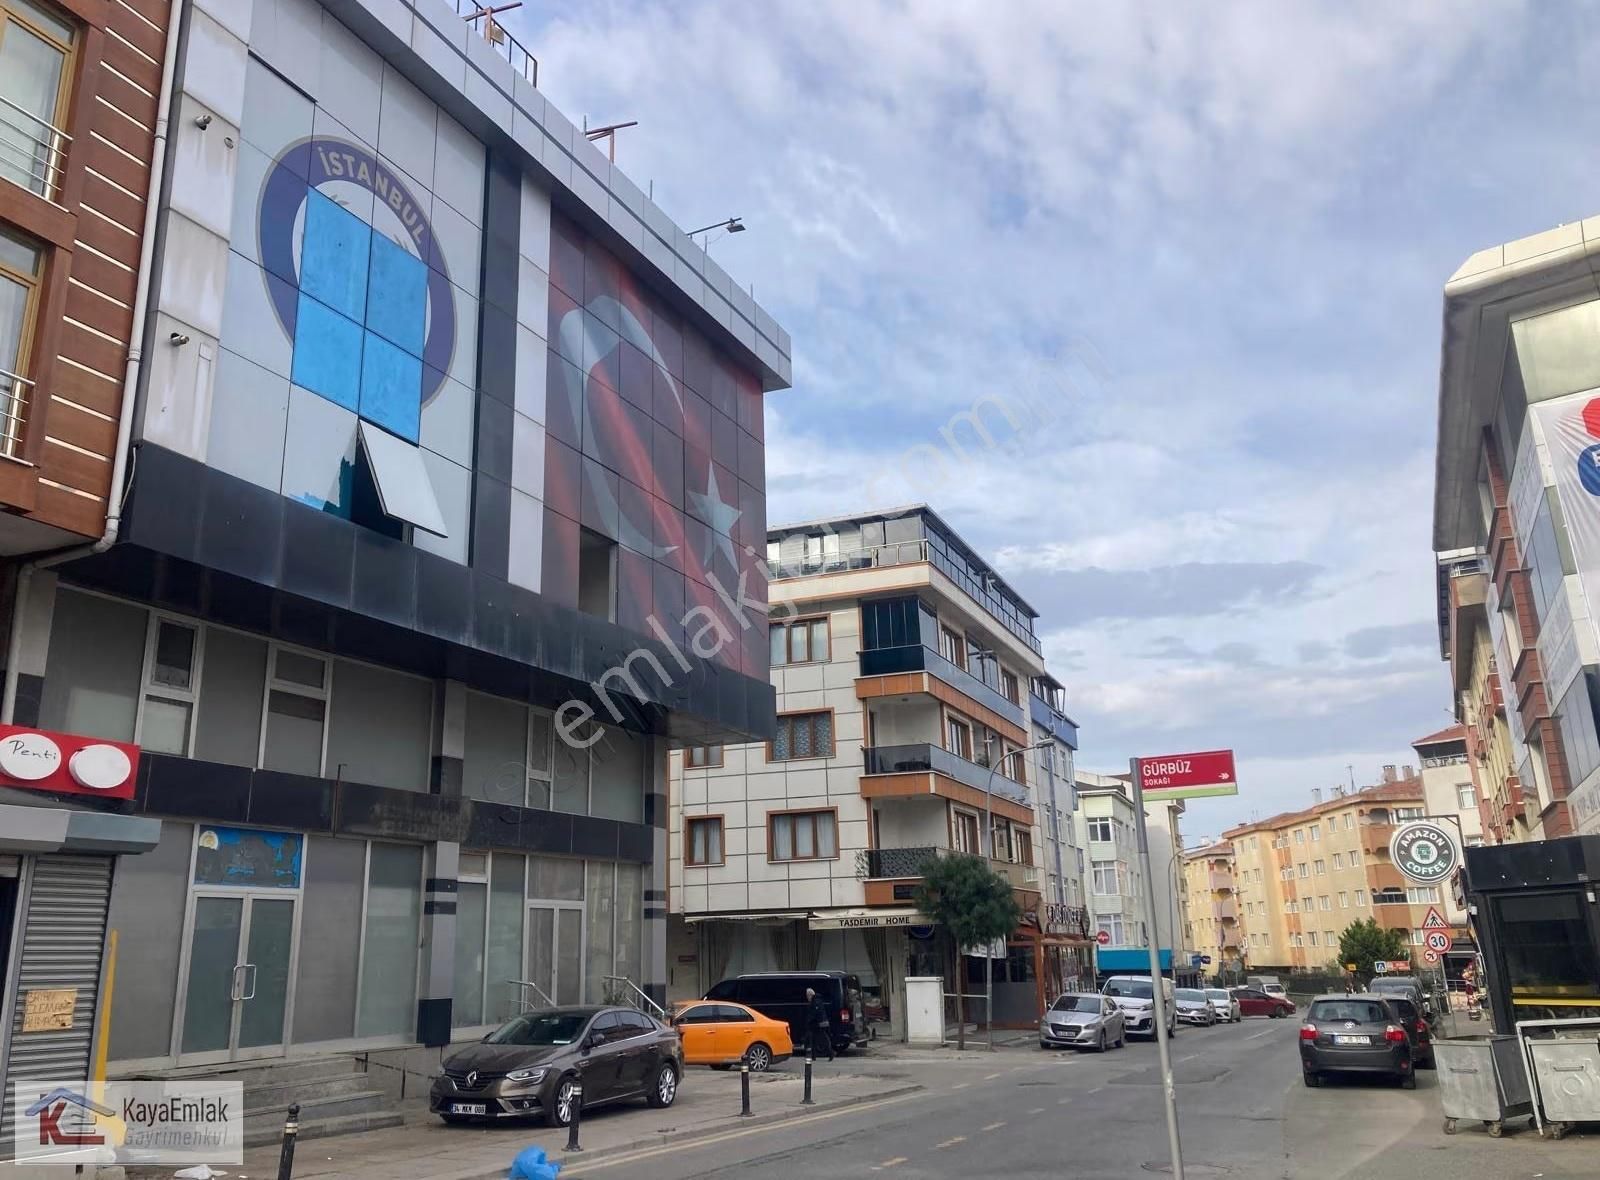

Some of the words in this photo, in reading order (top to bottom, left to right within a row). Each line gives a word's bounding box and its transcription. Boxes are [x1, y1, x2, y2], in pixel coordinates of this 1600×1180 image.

[318, 146, 425, 245] İSTANBUL
[9, 740, 57, 760] Penti
[1143, 759, 1193, 777] GÜRBÜZ
[1144, 777, 1171, 787] SOKAĞI
[1400, 830, 1446, 847] AMAZON
[1405, 860, 1447, 875] COFFEE
[885, 916, 911, 925] HOME
[1430, 935, 1446, 948] 30
